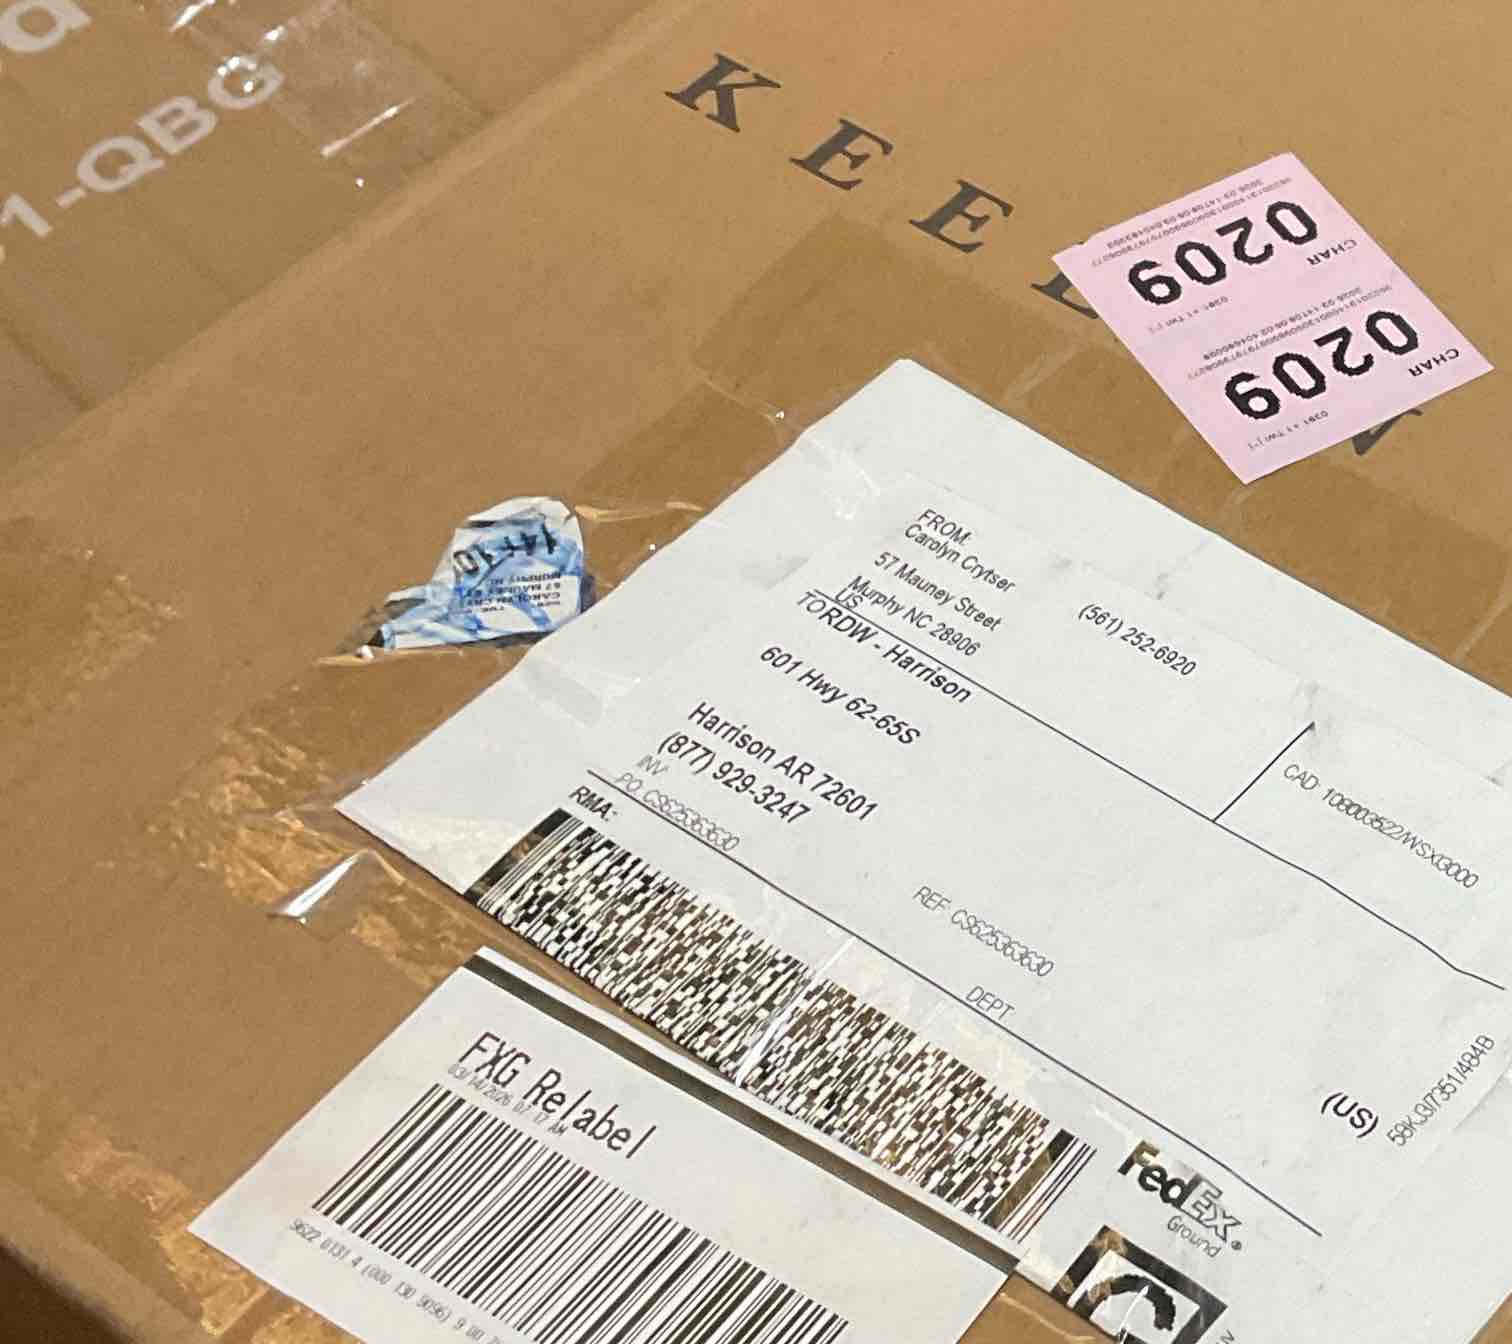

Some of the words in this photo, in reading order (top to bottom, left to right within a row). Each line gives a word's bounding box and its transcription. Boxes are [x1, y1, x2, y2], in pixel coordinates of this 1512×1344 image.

[1127, 200, 1317, 305] 0209
[1305, 238, 1356, 265] CHAR
[1224, 310, 1418, 419] 0209
[1407, 347, 1459, 377] CHAR
[873, 551, 900, 571] 57
[893, 562, 955, 606] Mauney
[953, 596, 1002, 632] Street
[904, 519, 961, 563] Carolyn
[960, 555, 1016, 593] Crytser
[834, 587, 864, 609] US
[844, 575, 905, 616] Murphy
[901, 606, 933, 629] NC
[928, 622, 981, 656] 28906
[881, 638, 971, 703] Harrison
[1077, 603, 1124, 636] (561)
[1119, 627, 1196, 676] 252-6920
[759, 646, 803, 675] 601
[796, 668, 848, 704] Hwy
[844, 697, 921, 744] 62-65S
[656, 731, 716, 775] (877)
[711, 761, 811, 824] 929-3247
[687, 701, 776, 764] Harrison
[772, 755, 815, 785] AR
[809, 773, 878, 821] 72601
[457, 1031, 531, 1089] FXG
[521, 1068, 656, 1159] Relabel
[1320, 1092, 1379, 1139] (US)
[1165, 1215, 1222, 1259] Ground
